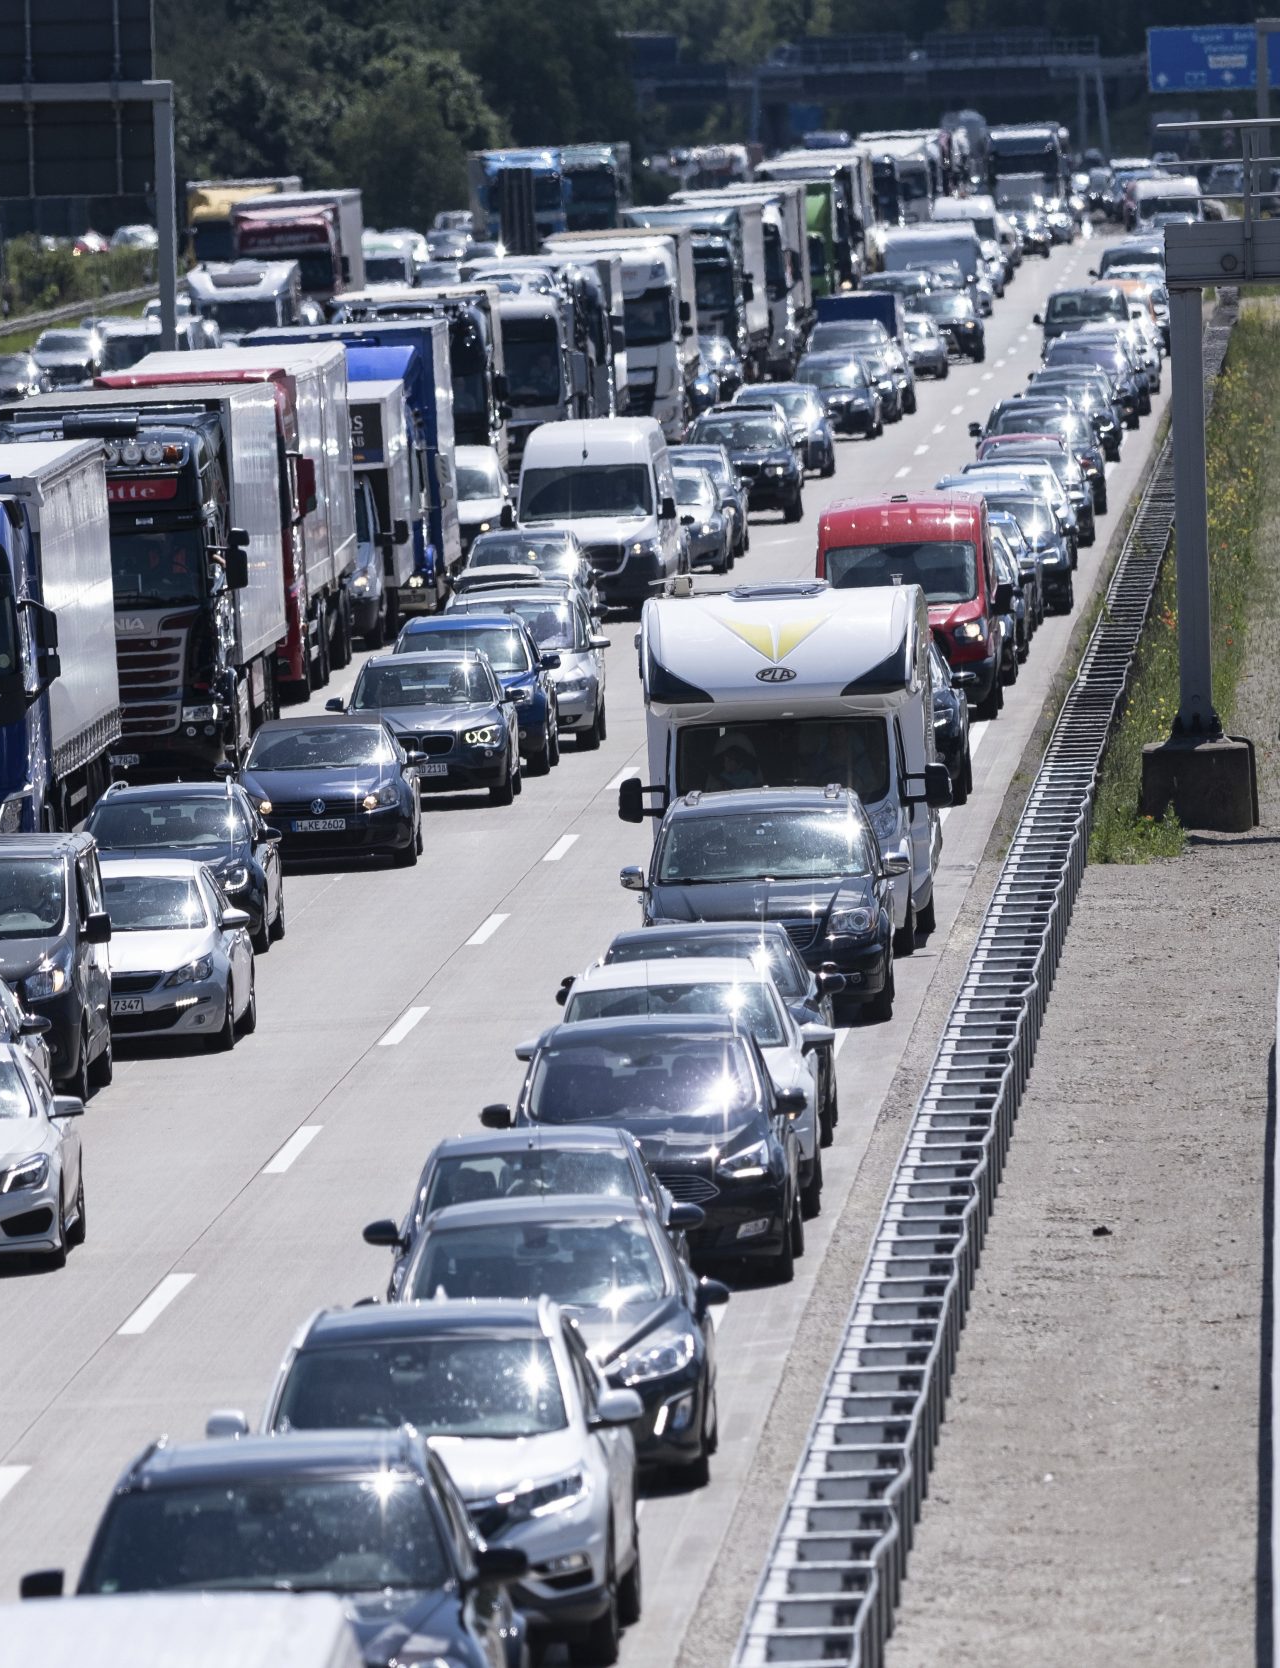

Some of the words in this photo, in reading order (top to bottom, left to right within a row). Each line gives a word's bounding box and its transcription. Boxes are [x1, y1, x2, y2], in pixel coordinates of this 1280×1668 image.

[114, 617, 145, 631] NIA
[322, 819, 345, 830] 2602
[113, 999, 140, 1011] 7347
